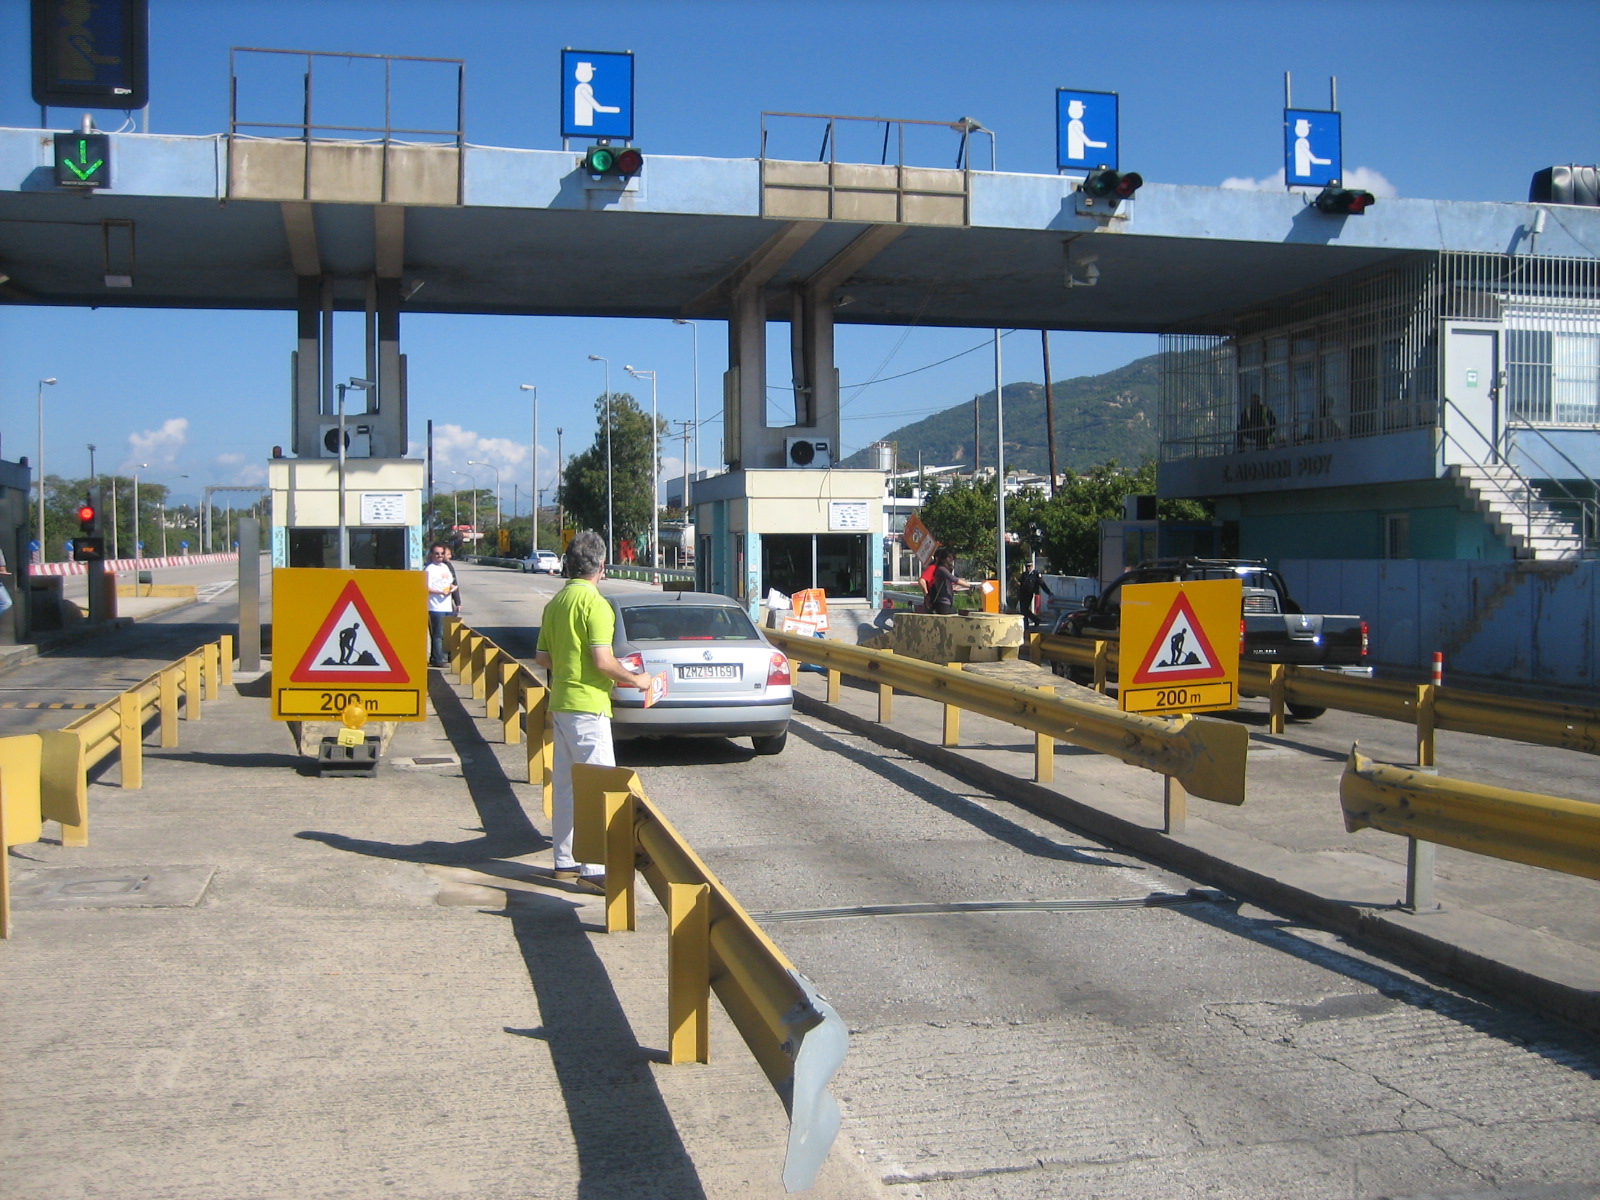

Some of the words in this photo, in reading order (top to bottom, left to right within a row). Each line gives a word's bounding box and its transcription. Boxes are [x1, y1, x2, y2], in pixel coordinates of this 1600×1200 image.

[1297, 454, 1333, 477] ΡΙΟΥ
[365, 699, 378, 711] m
[1156, 689, 1187, 707] 200
[1190, 693, 1201, 704] m
